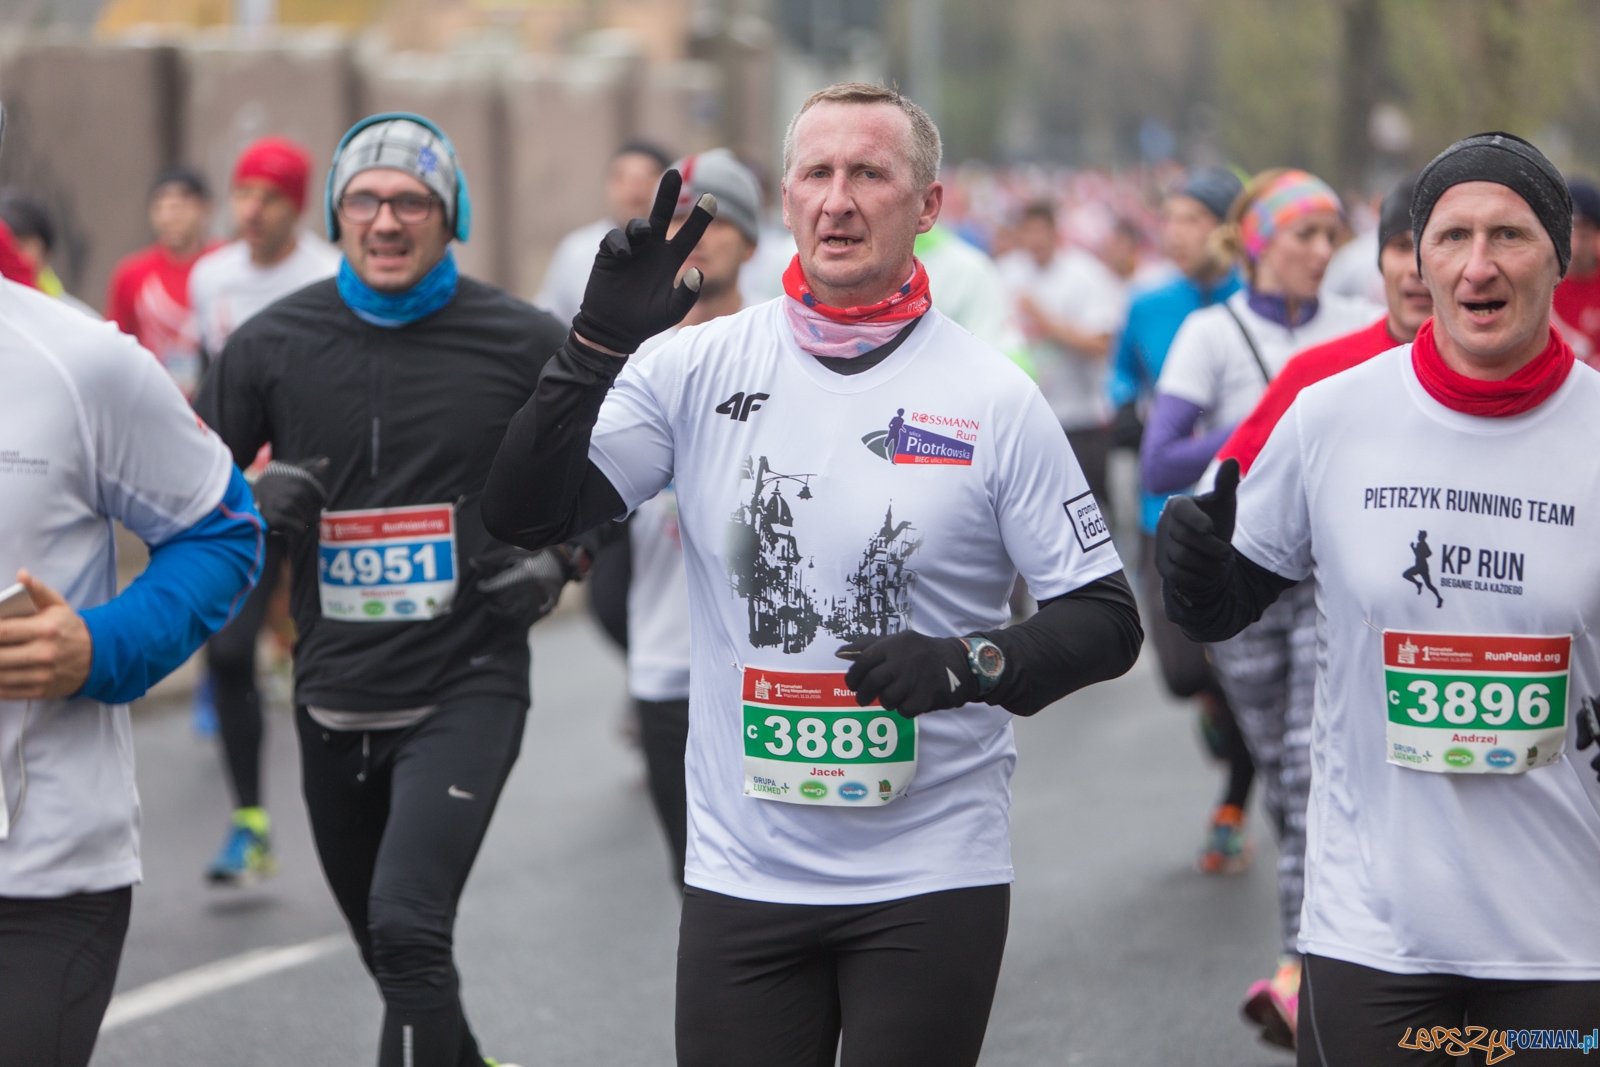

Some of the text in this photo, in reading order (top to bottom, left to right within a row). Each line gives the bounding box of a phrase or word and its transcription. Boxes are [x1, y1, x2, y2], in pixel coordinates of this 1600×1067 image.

[715, 391, 770, 422] 4F
[911, 412, 980, 431] ROSSMANN
[908, 430, 921, 438] ulica
[956, 429, 977, 441] Run
[906, 436, 970, 460] Piotrkowska
[1364, 487, 1576, 527] PIETRZYK RUNNING TEAM
[329, 543, 437, 585] 4951
[1441, 544, 1524, 582] KP RUN
[1440, 577, 1472, 590] BIEGANIE
[1474, 580, 1488, 592] DLA
[1484, 652, 1561, 664] RunPoland.org
[774, 683, 782, 697] 1
[1388, 680, 1551, 726] C 3896
[746, 715, 899, 759] C 3889
[1451, 733, 1498, 745] Andrzej
[809, 767, 845, 777] Jacek
[753, 776, 777, 787] GRUPA
[753, 783, 781, 795] LUXMED
